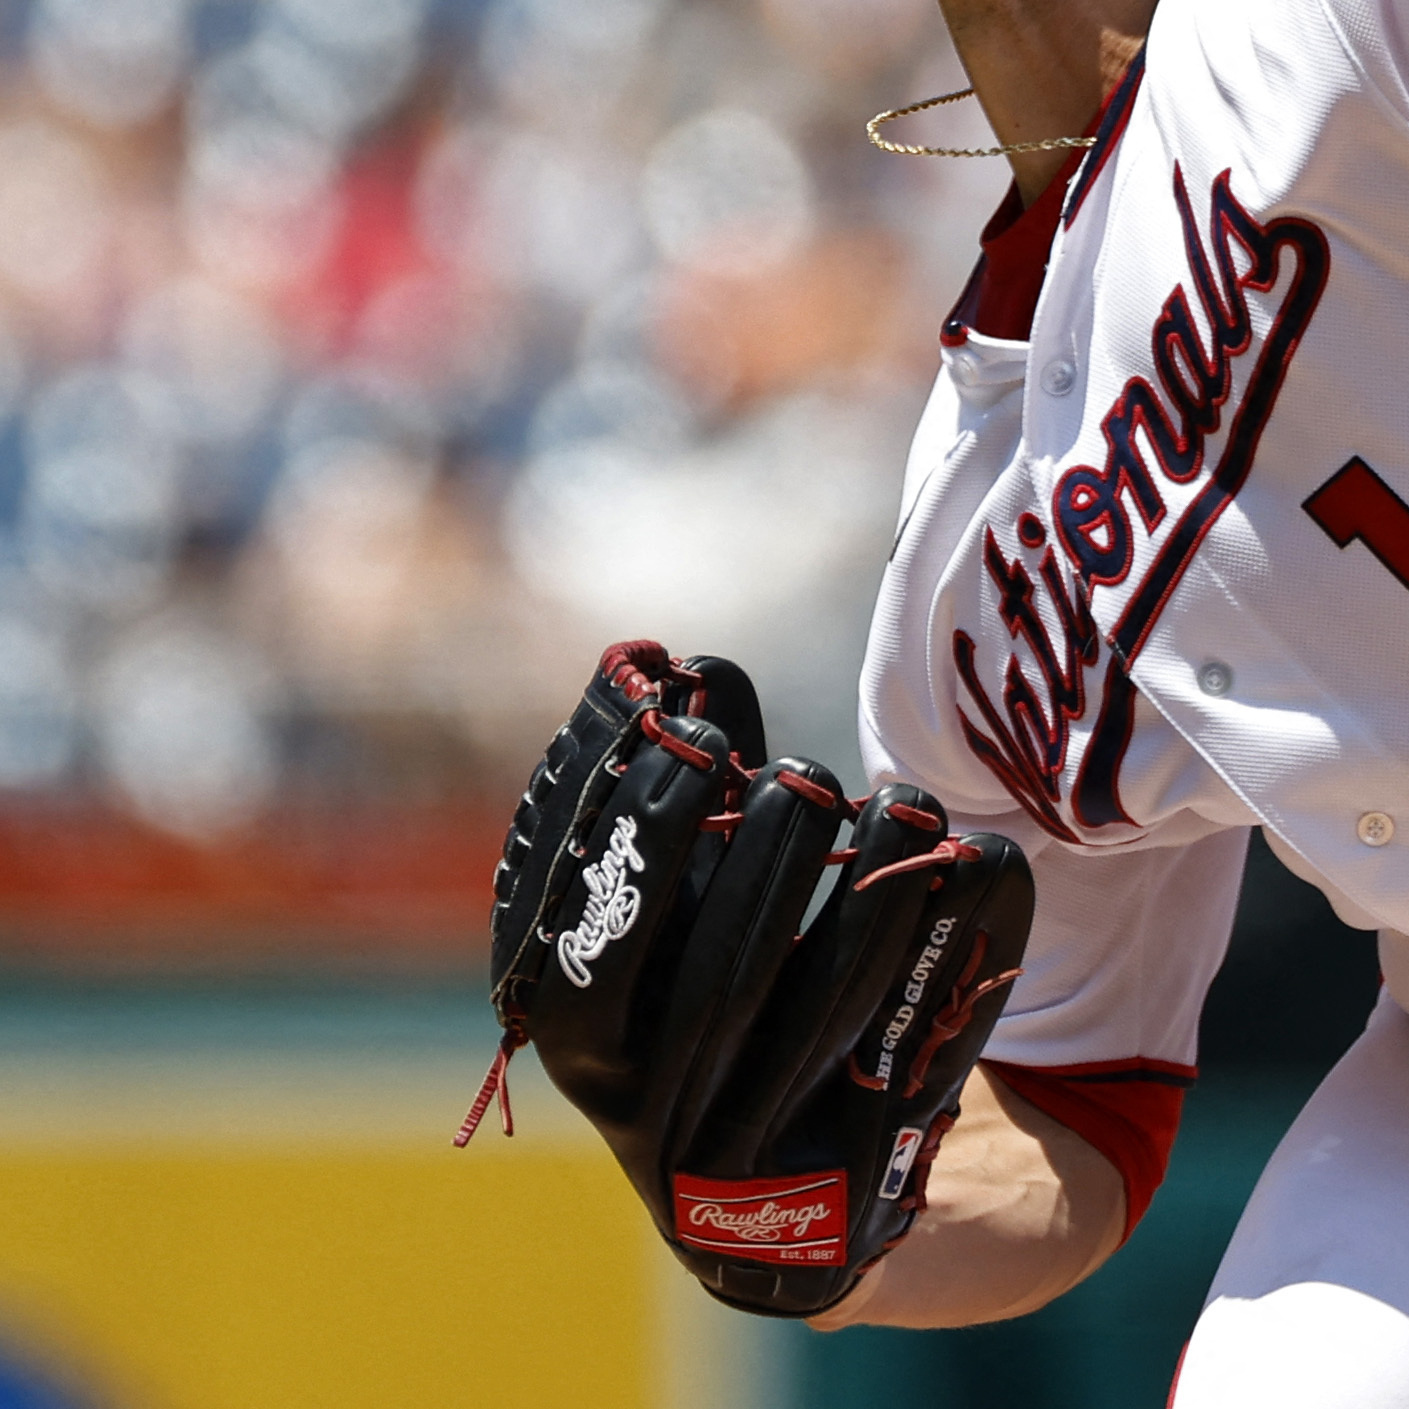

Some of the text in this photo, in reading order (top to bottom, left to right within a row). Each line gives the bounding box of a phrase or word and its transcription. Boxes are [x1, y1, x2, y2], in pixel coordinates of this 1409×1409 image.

[953, 158, 1330, 846] Nationals
[558, 814, 645, 989] Rawlings
[882, 1004, 914, 1051] GOLD
[904, 944, 943, 1004] GLOVE
[930, 916, 957, 946] CO.
[688, 1201, 832, 1237] Rawlings
[778, 1249, 837, 1261] Est. 1887
